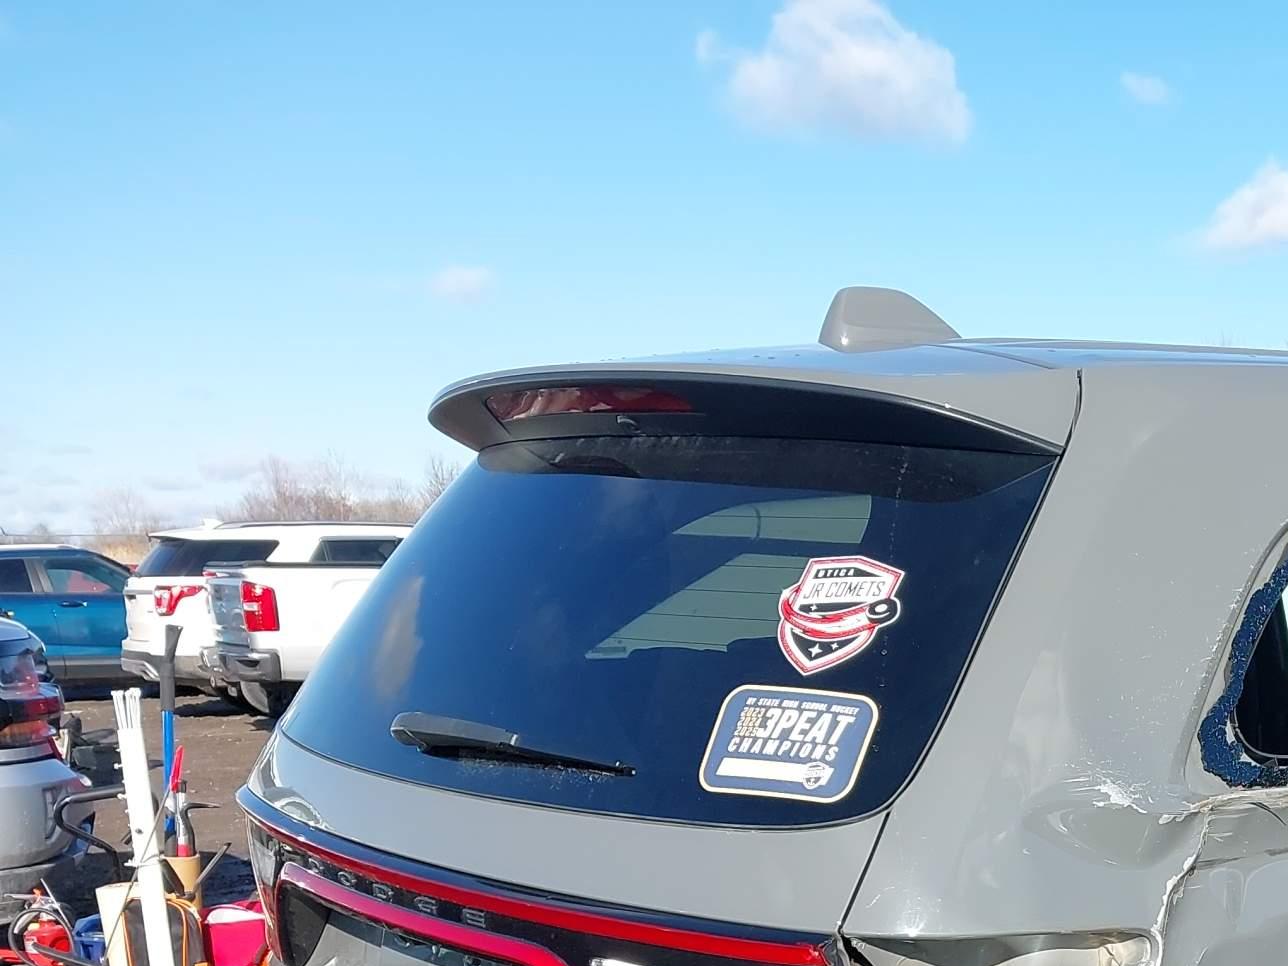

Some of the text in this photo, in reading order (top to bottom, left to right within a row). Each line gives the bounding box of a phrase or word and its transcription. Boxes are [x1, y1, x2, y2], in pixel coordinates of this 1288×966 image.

[803, 581, 886, 599] JR COMETS
[741, 707, 765, 717] 2023
[758, 698, 780, 706] STATE
[758, 707, 856, 745] 3PEAT
[727, 737, 839, 761] CHAMPIONS
[308, 857, 488, 929] DODGE
